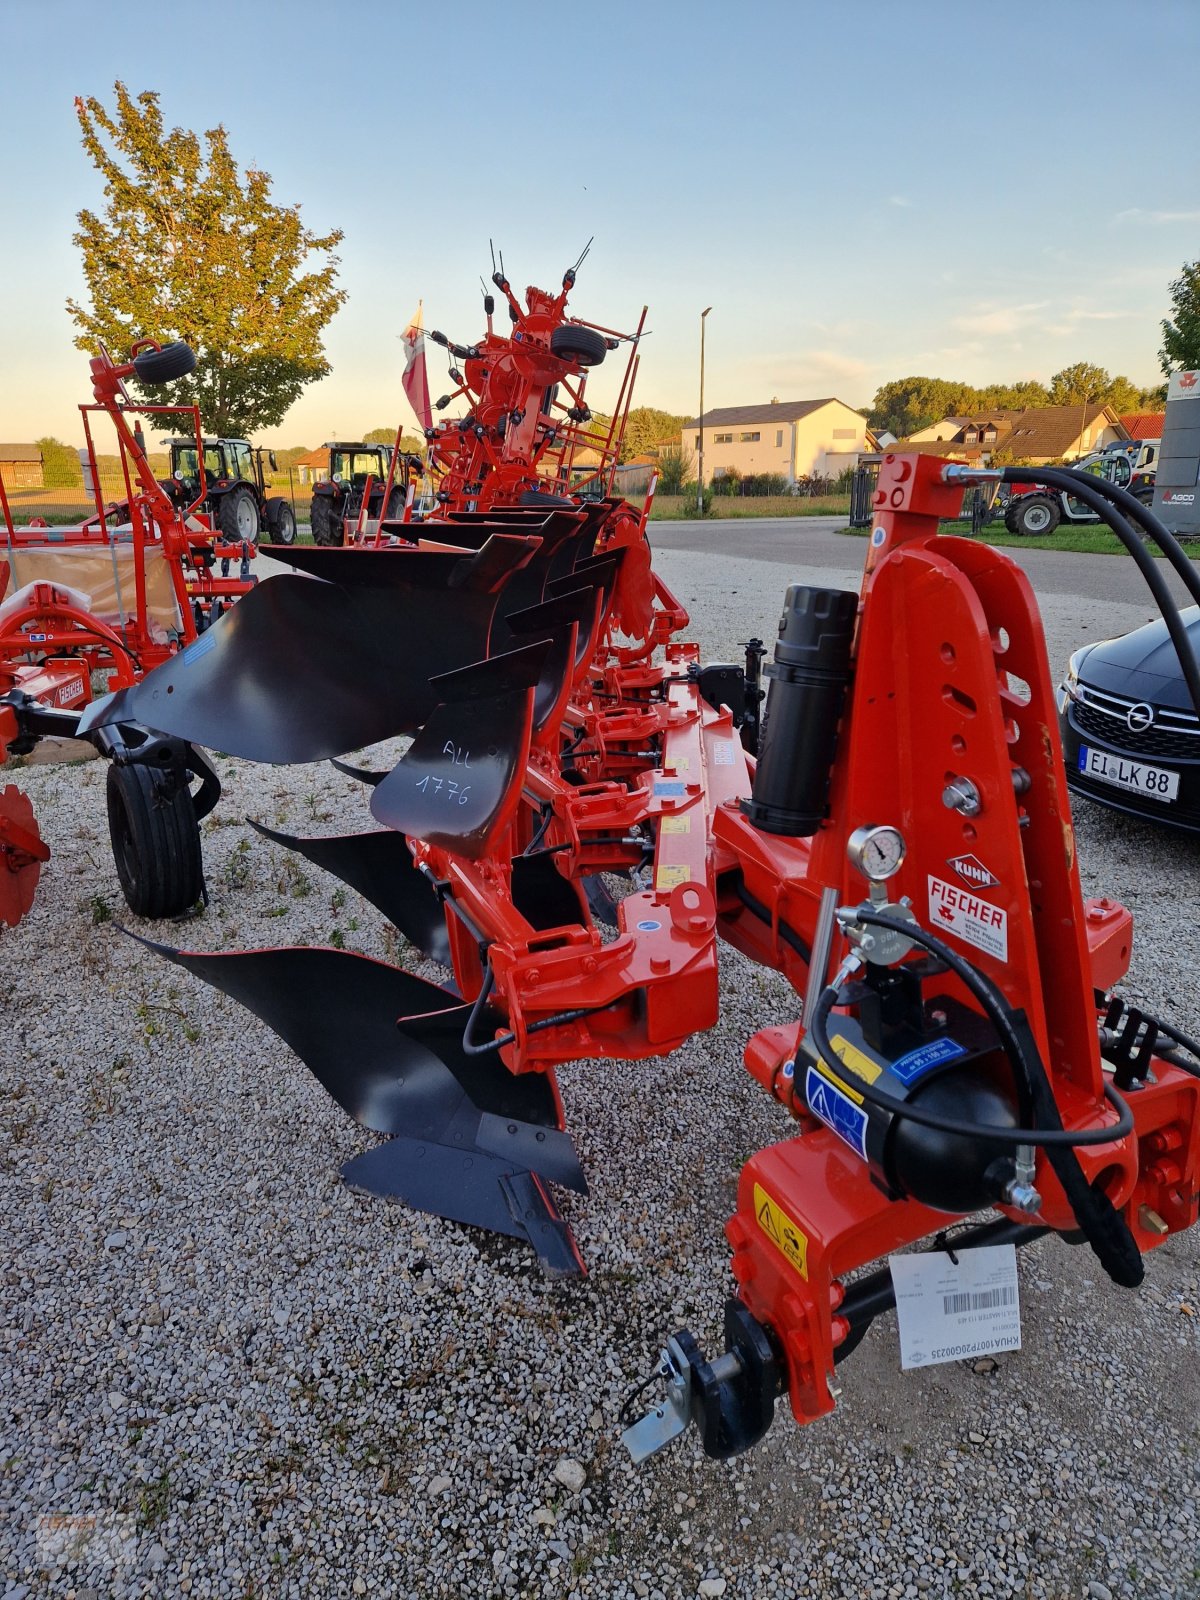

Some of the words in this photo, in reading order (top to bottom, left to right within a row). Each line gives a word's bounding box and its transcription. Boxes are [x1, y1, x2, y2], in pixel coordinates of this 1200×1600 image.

[61, 680, 82, 702] FISCHER
[443, 740, 472, 769] ALL
[1091, 753, 1108, 775] EI
[1118, 762, 1142, 786] LK
[1145, 770, 1170, 793] 88
[416, 775, 472, 805] 1776
[955, 860, 991, 884] KUHN
[931, 881, 1004, 930] FISCHER
[931, 1336, 1019, 1359] KHUA1007P20G00235
